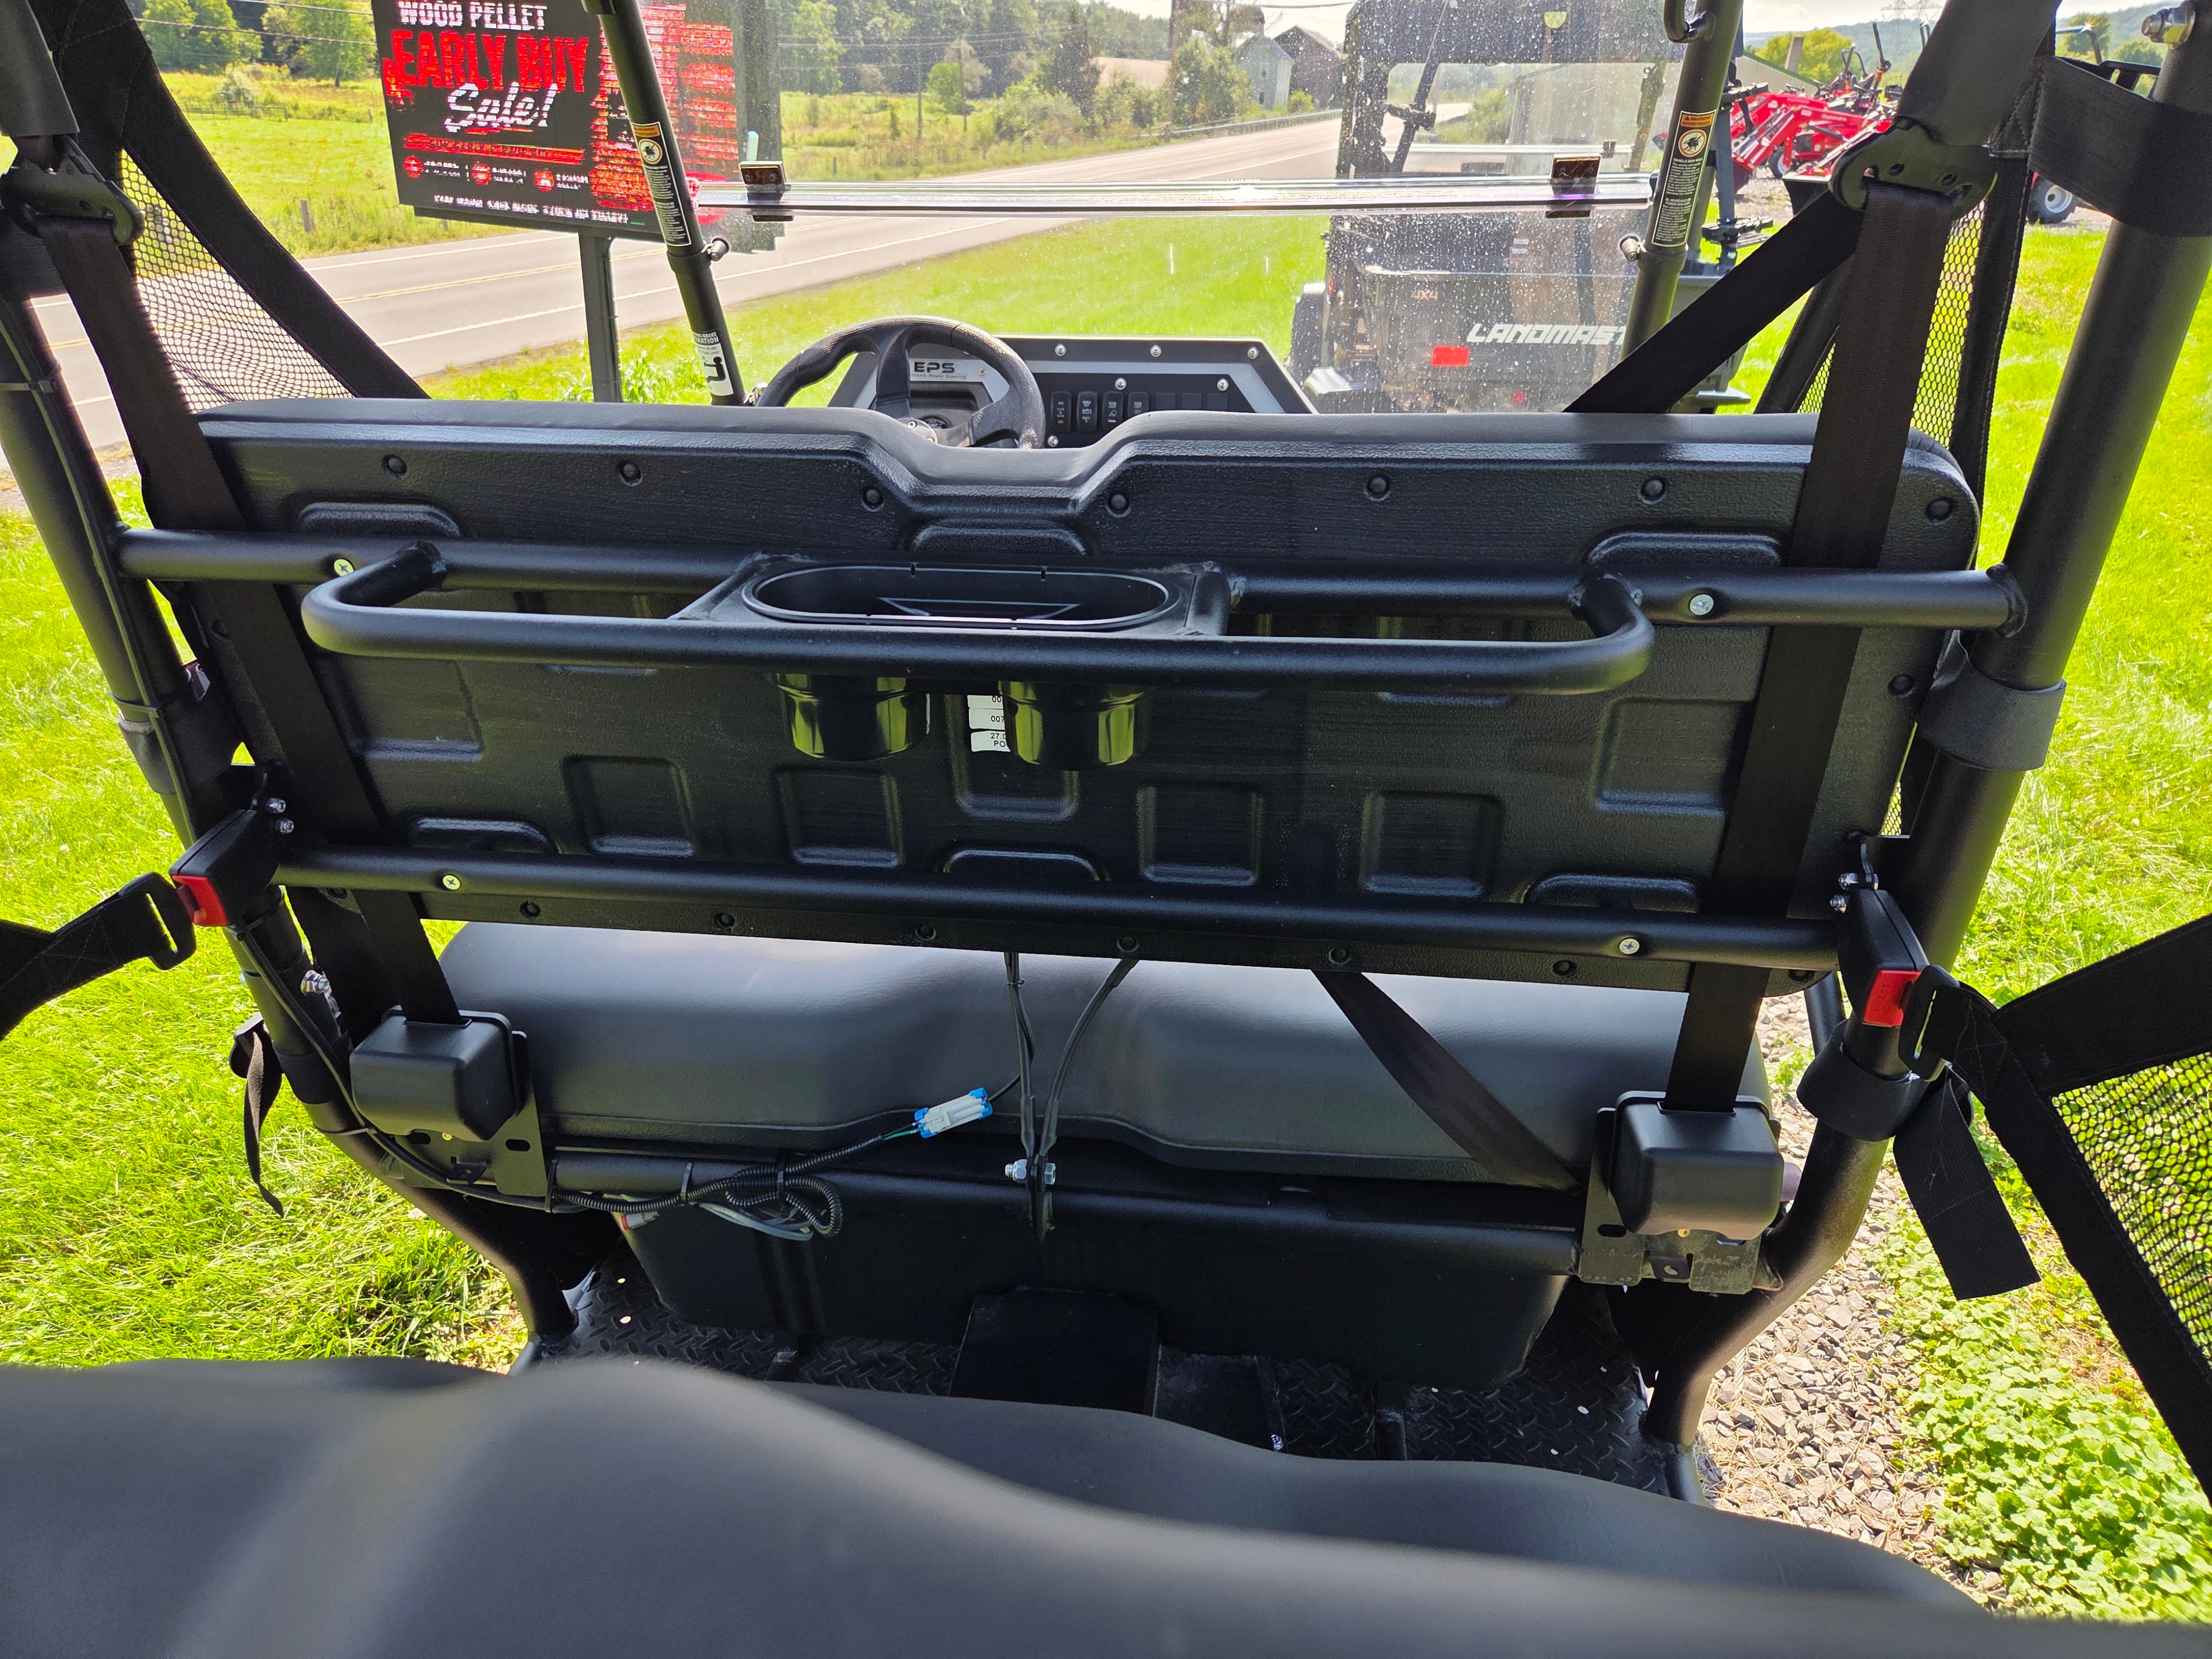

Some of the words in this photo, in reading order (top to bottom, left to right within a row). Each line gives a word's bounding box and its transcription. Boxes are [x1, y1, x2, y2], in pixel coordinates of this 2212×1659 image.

[397, 1, 463, 27] WOOD
[469, 2, 547, 31] PELLET
[391, 30, 507, 91] EARLY
[516, 34, 589, 92] BUY
[444, 81, 560, 133] Sale!
[1466, 323, 1628, 346] LANDMAST
[914, 361, 955, 374] EPS
